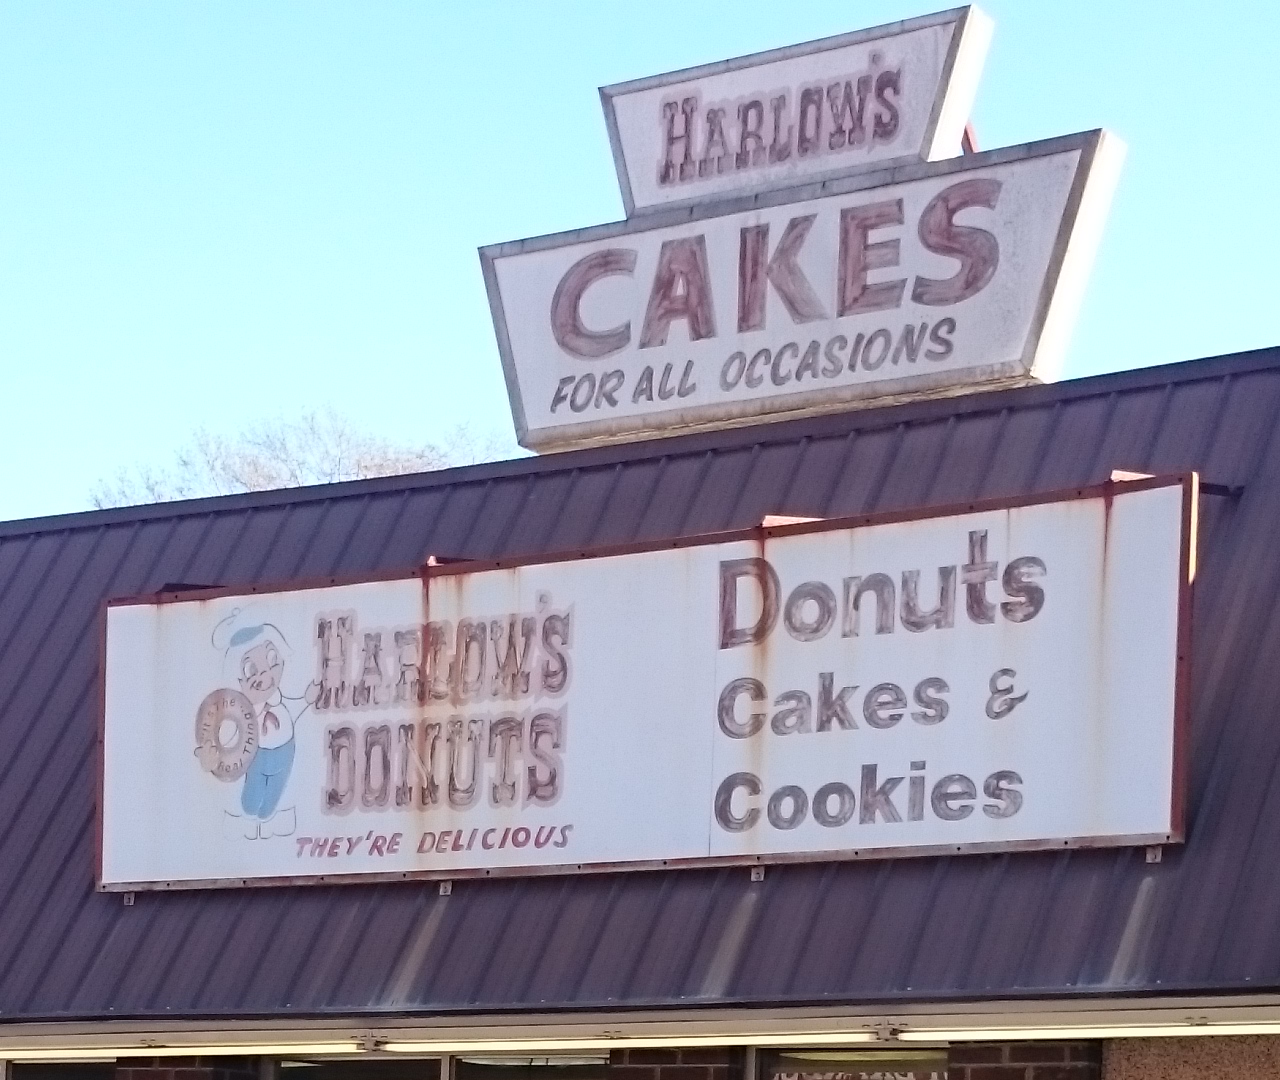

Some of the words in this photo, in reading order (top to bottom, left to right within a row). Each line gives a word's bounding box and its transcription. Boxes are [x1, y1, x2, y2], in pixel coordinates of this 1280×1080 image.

[550, 178, 1003, 361] CAKES
[550, 368, 625, 414] FOR
[631, 358, 698, 405] ALL
[719, 317, 957, 394] OCCASIONS
[718, 529, 1048, 650] Donuts
[717, 671, 952, 740] Cakes
[985, 668, 1030, 720] &
[323, 712, 567, 813] DONUTS
[714, 760, 1024, 834] Cookies
[295, 829, 402, 859] THEY'RE
[417, 824, 575, 856] DELICIOUS
